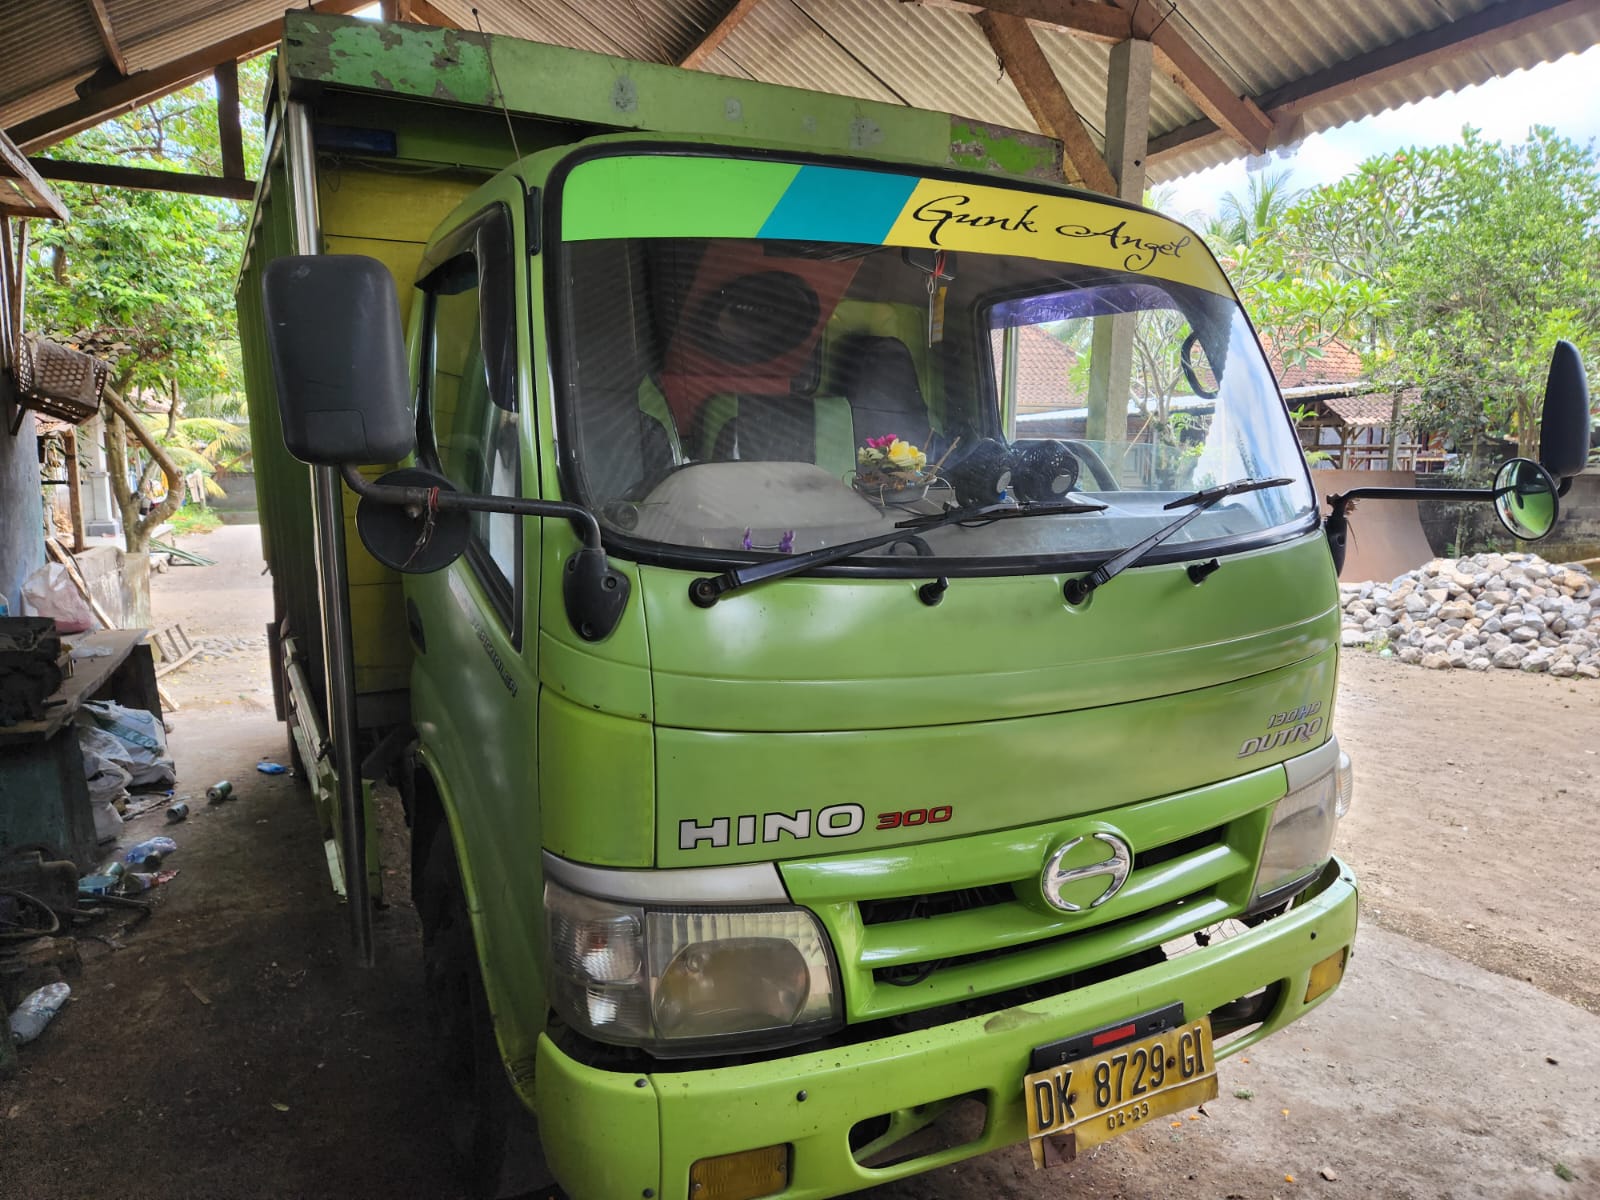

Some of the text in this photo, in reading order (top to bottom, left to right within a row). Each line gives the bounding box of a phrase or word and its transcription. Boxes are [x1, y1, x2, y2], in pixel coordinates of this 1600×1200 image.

[912, 195, 1191, 272] Gunk Angel
[1236, 716, 1323, 759] DUTRO
[678, 802, 953, 850] HINO 300
[1033, 1026, 1205, 1130] DK 8729 GI
